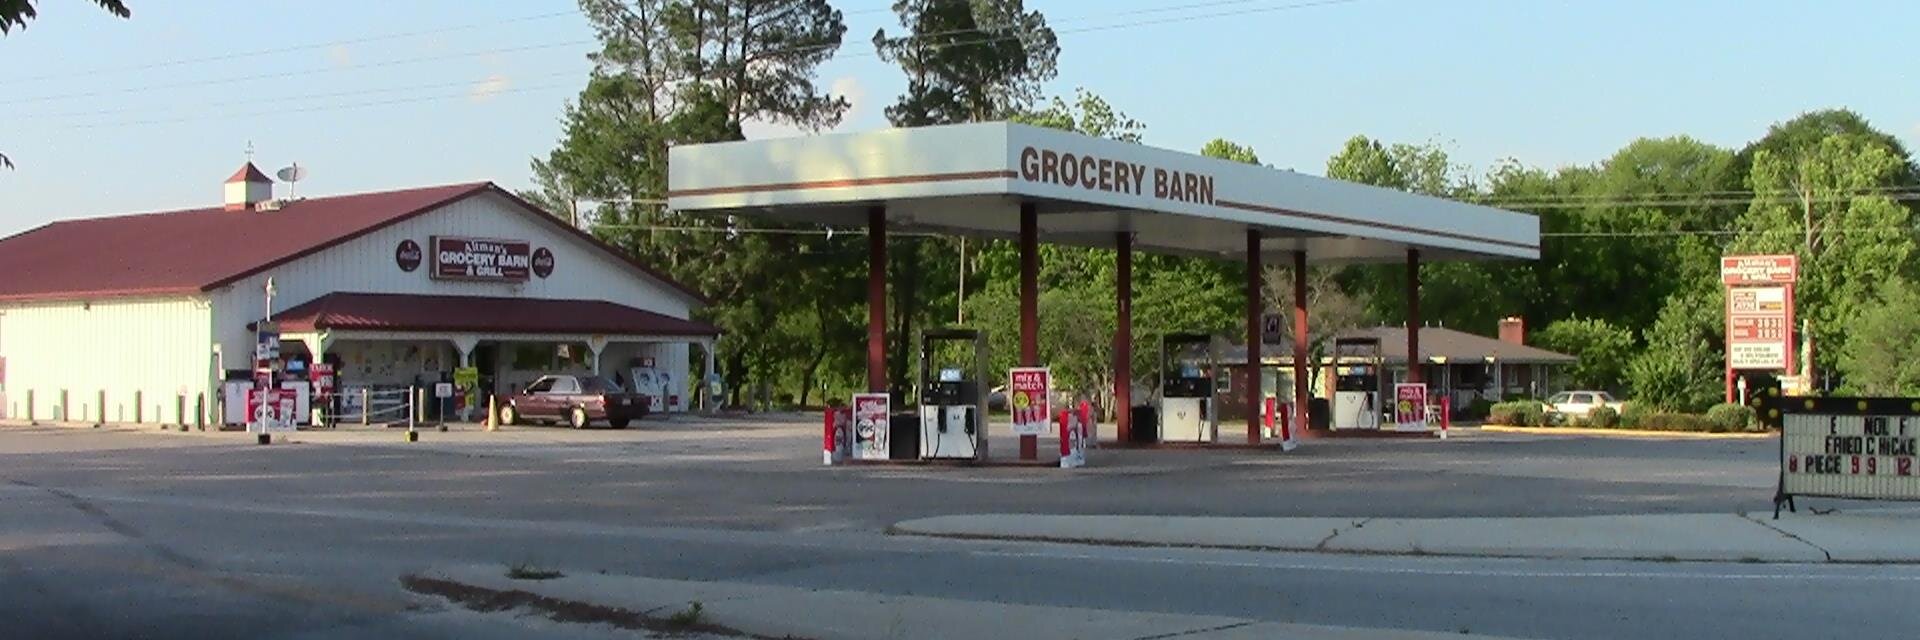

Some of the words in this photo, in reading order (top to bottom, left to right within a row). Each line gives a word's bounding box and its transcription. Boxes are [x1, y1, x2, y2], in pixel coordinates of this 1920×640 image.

[1020, 146, 1146, 195] GROCERY
[1154, 168, 1214, 206] BARN
[439, 250, 495, 267] GROCERY
[499, 256, 528, 268] BARN
[466, 266, 473, 276] &
[476, 267, 504, 277] GRILL
[1014, 381, 1044, 390] match
[1015, 373, 1032, 382] mix
[1830, 416, 1837, 434] E
[1825, 436, 1862, 454] FRIED
[1789, 455, 1798, 473] 8
[1805, 455, 1841, 474] PIECE
